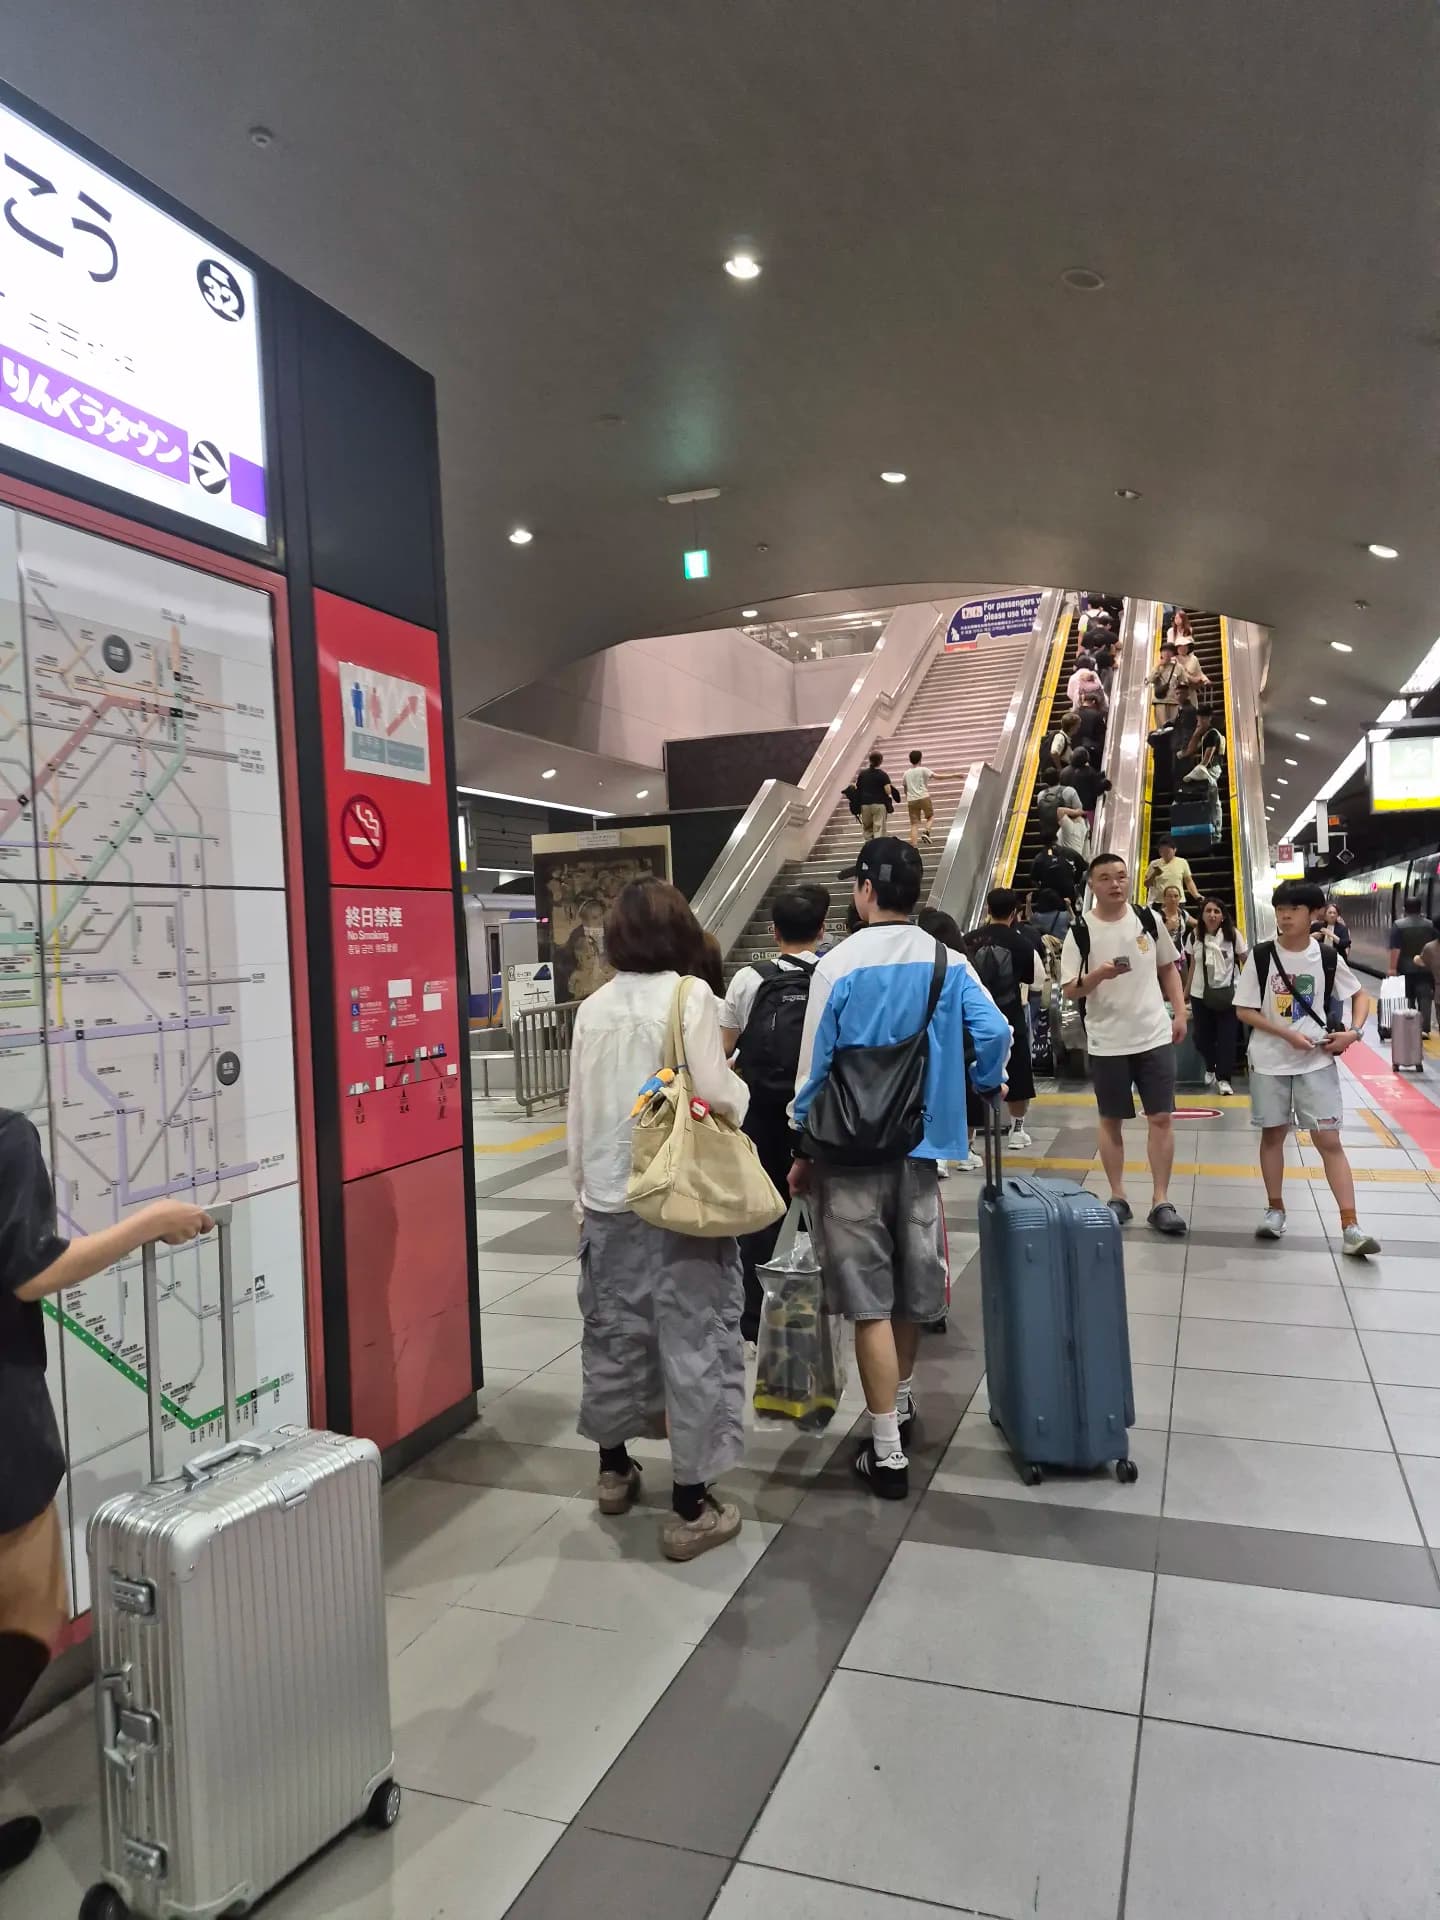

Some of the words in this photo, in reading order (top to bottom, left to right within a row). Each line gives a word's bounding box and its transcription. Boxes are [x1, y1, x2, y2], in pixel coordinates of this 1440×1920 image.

[2, 356, 182, 463] りんくうタウン
[983, 602, 995, 611] For
[996, 598, 1035, 609] passengers
[983, 612, 1006, 622] please
[1007, 610, 1020, 618] use
[1021, 607, 1033, 616] the
[345, 906, 403, 928] 終日禁煙
[347, 930, 358, 940] No
[358, 930, 390, 942] Smoking
